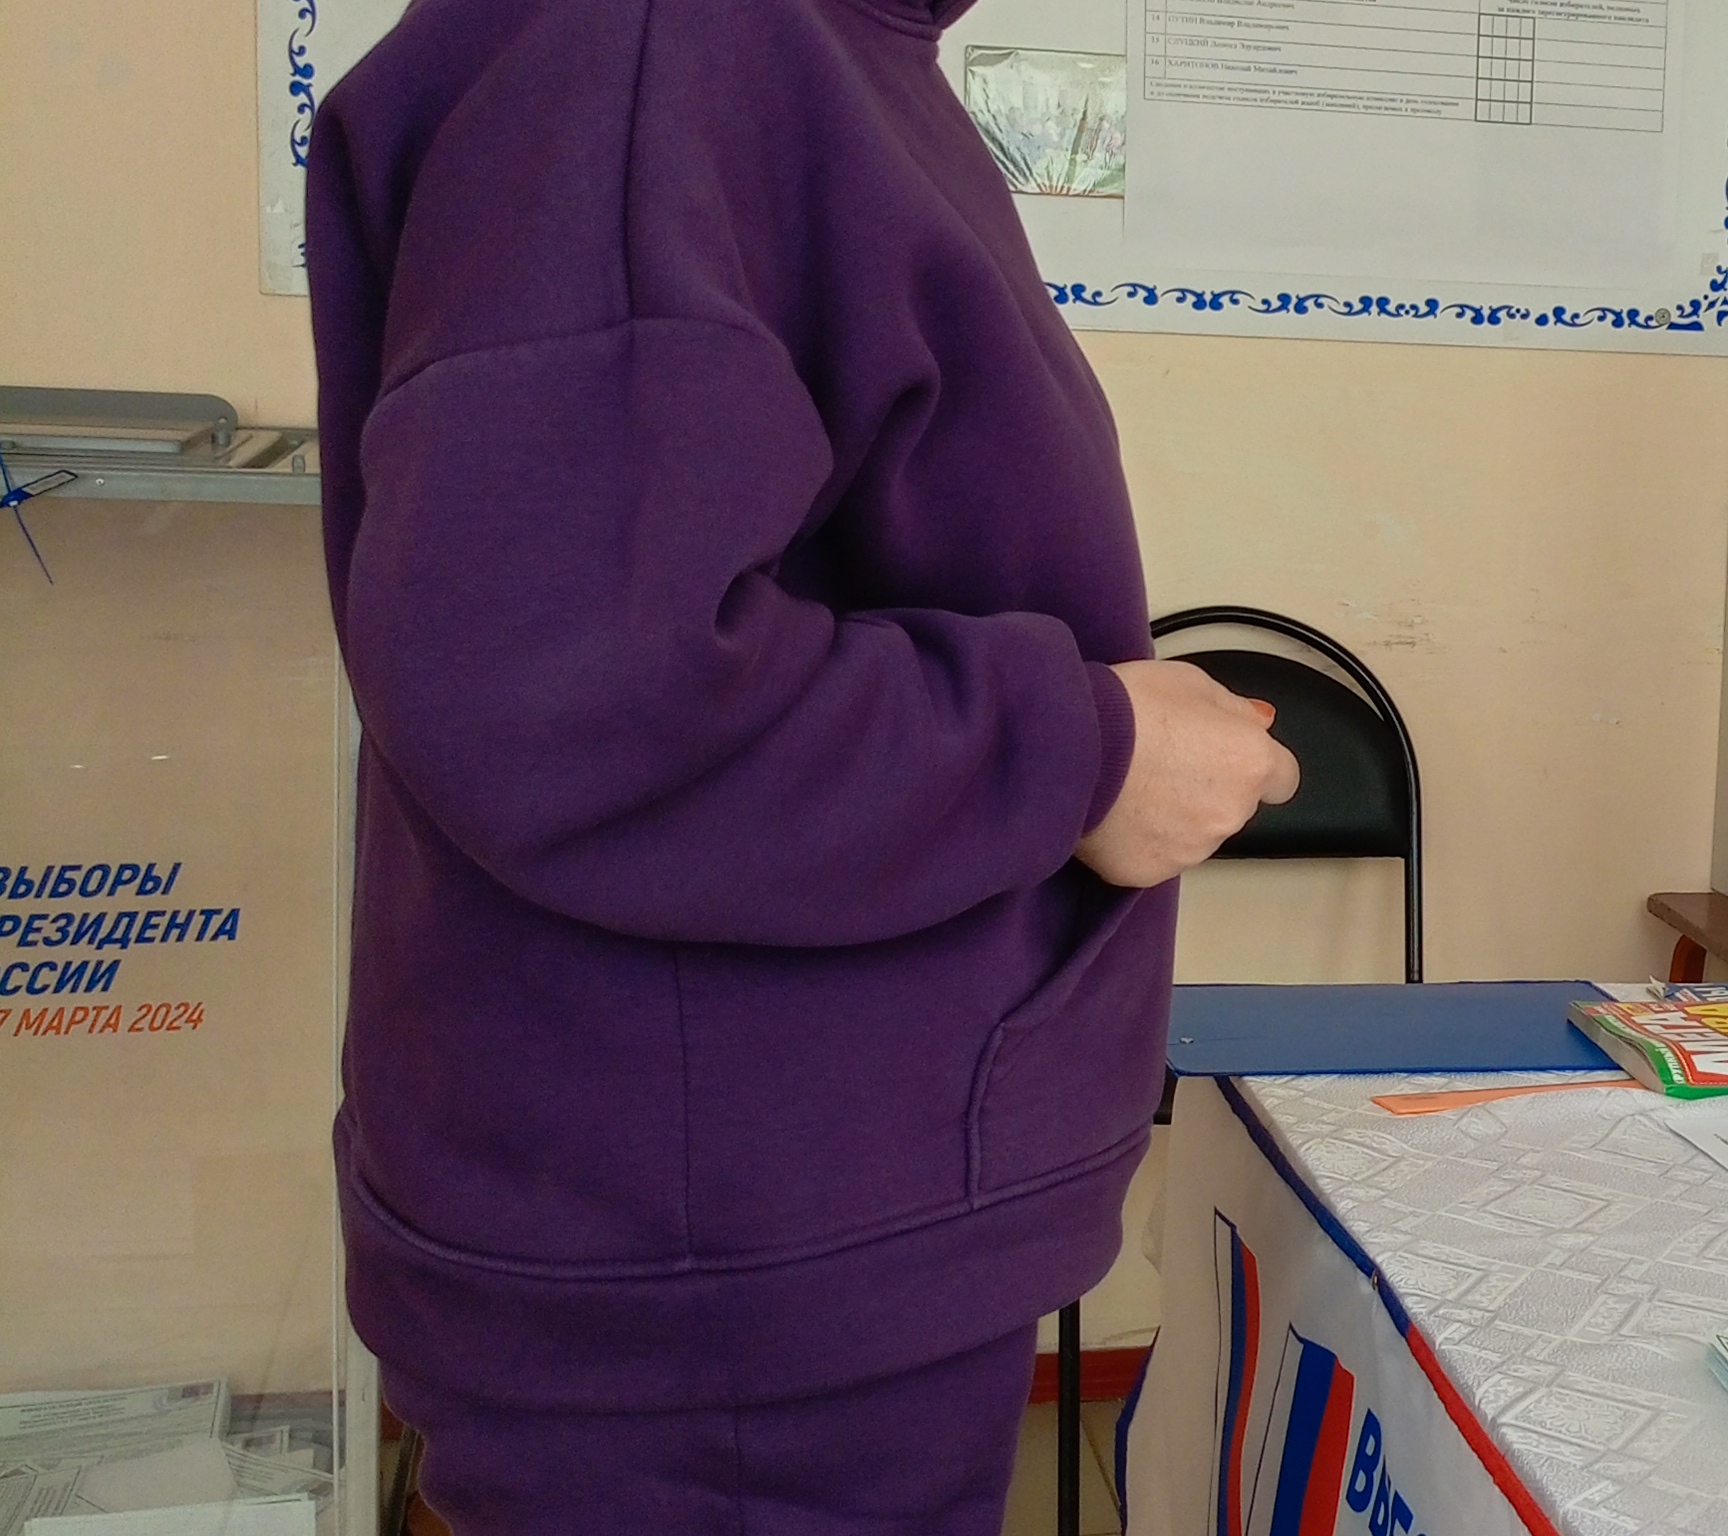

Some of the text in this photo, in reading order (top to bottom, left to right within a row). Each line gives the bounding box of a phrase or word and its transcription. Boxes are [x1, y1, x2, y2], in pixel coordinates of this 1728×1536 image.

[0, 862, 182, 899] ВЫБОРЫ
[0, 959, 121, 997] ССИИ
[14, 1004, 123, 1037] МАРТА
[128, 1001, 205, 1034] 2024
